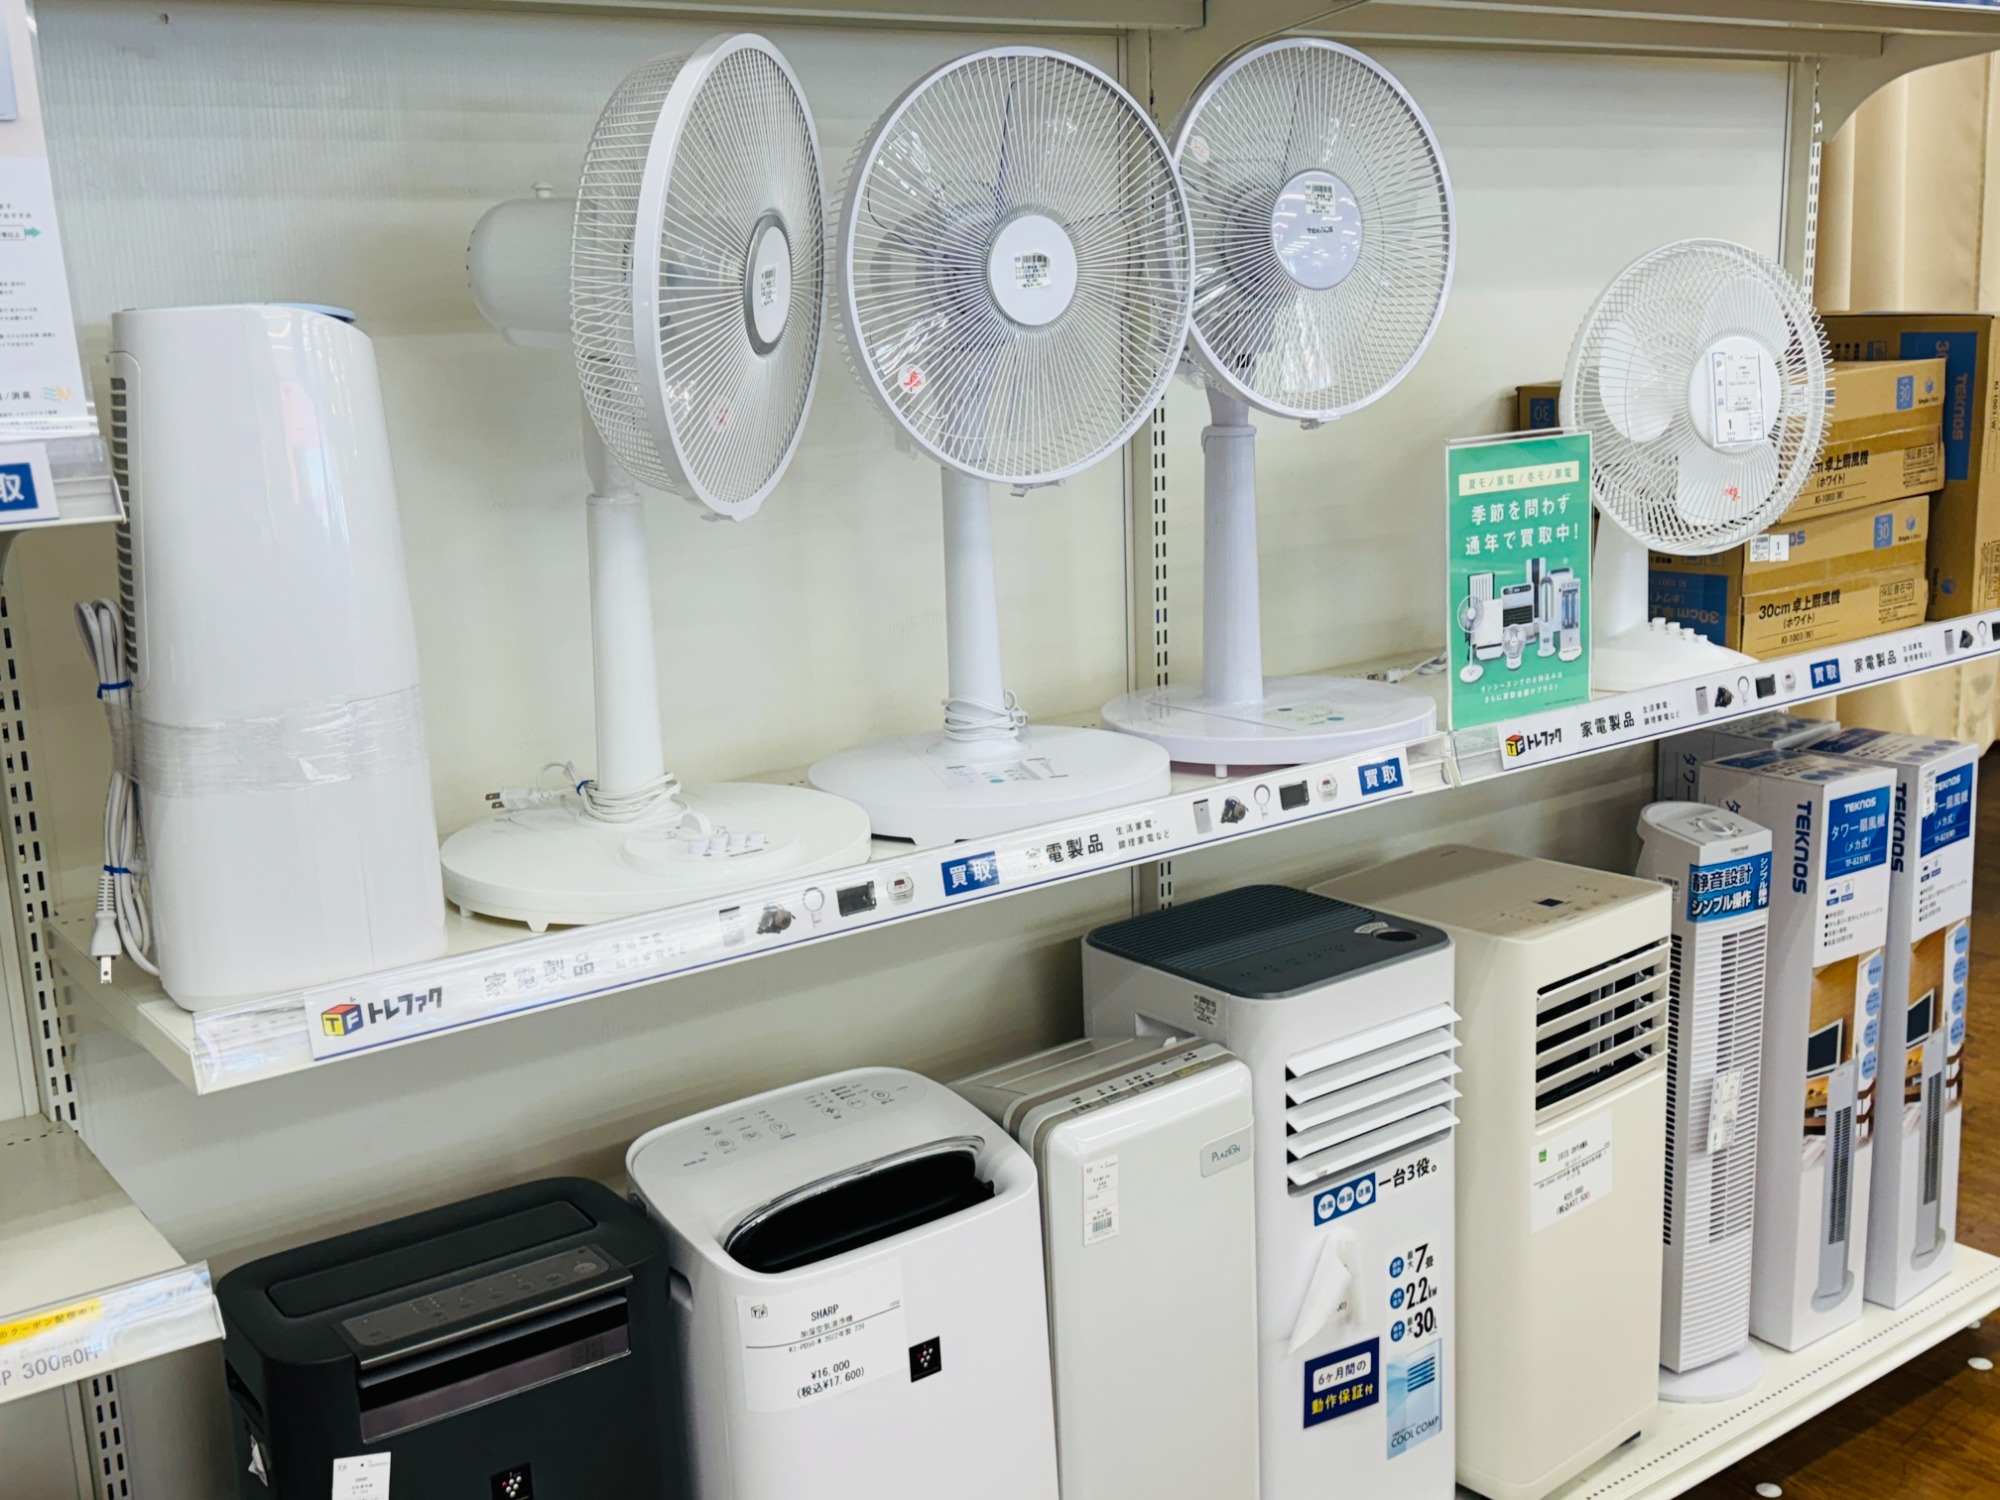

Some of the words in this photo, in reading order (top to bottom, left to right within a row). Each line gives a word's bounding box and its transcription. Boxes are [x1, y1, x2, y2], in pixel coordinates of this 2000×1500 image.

[1900, 385, 1911, 402] 30
[1952, 372, 1968, 441] TEKNOS
[1816, 472, 1846, 488] (ホワイト)
[1471, 493, 1571, 526] 季節を問わず
[1465, 522, 1578, 556] 通年で買取中!
[1876, 522, 1889, 540] 30
[1783, 612, 1816, 629] (ホワイト)
[1814, 664, 1837, 684] 買取
[1854, 650, 1897, 673] 家電製品
[1580, 711, 1635, 738] 家電製品
[1527, 728, 1563, 750] トレファク
[1364, 765, 1398, 789] 買取
[1844, 796, 1877, 814] TEKNOS
[1118, 829, 1170, 850] 調理家電など
[1831, 813, 1886, 841] タワー扇風機
[1891, 782, 1907, 873] TEKNOS
[1792, 801, 1812, 894] TEKNOS
[1845, 835, 1871, 853] (メカ式)
[949, 858, 993, 889] 買取
[1692, 863, 1753, 893] 静音設計
[1691, 889, 1752, 916] シンプル操作
[368, 986, 443, 1024] トレファク
[1379, 1157, 1437, 1188] 一台3役。
[811, 1303, 839, 1322] SHARP
[811, 1359, 850, 1380] ¥16,000
[797, 1367, 865, 1399] (税込¥17,600)
[1311, 1383, 1373, 1415] 動作保証付
[1391, 1430, 1414, 1448] COOL
